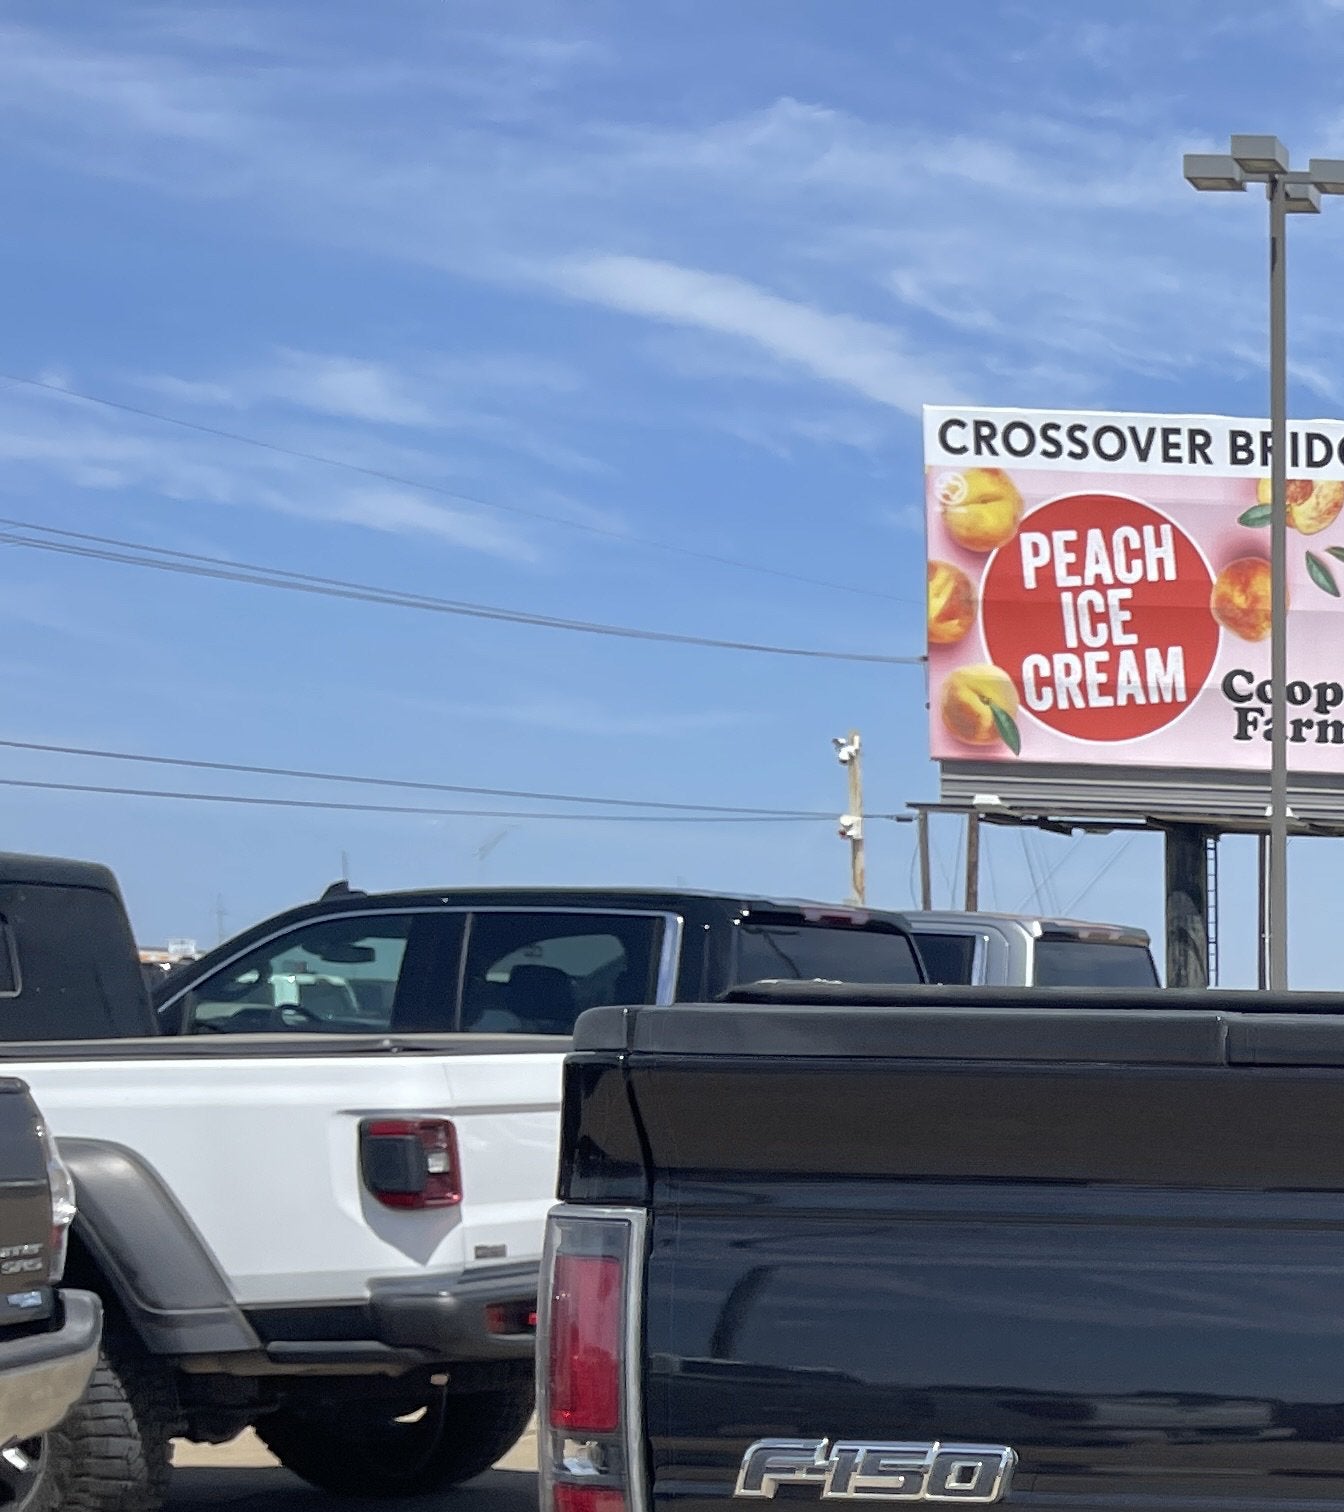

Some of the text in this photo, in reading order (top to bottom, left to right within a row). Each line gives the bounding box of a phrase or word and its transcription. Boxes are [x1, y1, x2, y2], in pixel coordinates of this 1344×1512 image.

[938, 418, 1213, 465] CROSSOVER
[1019, 524, 1178, 590] PEACH
[1061, 588, 1138, 649] ICE
[1021, 646, 1187, 712] CREAM
